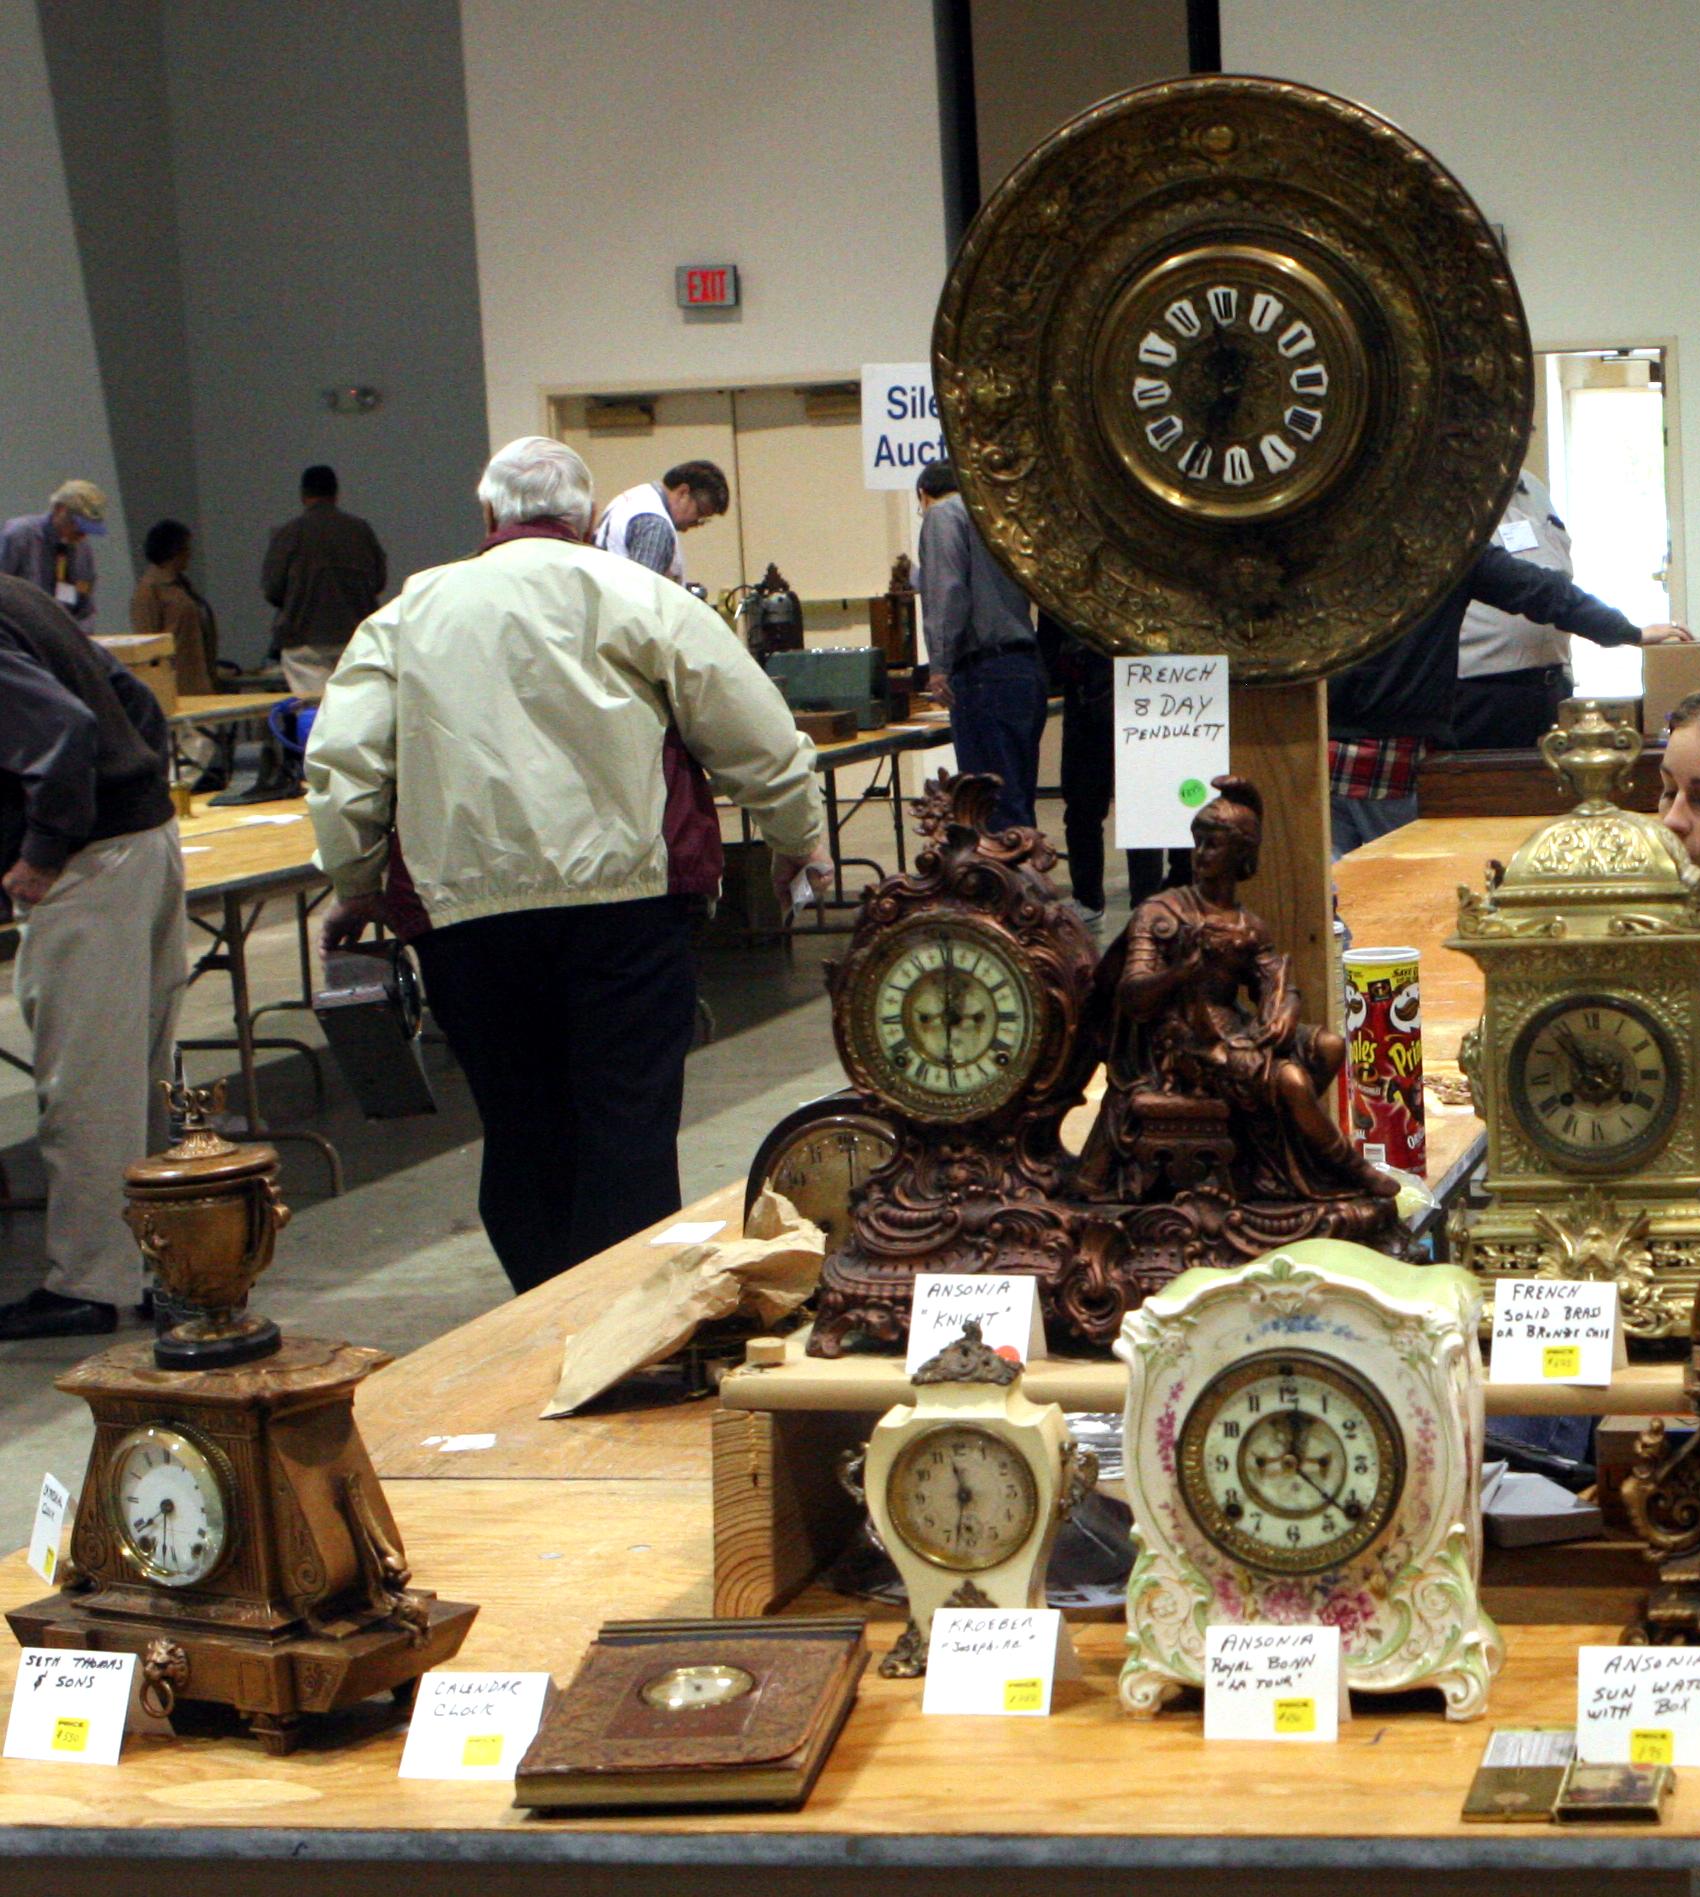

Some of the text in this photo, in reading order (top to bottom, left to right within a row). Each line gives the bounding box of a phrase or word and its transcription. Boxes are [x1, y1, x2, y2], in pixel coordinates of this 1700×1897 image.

[687, 270, 727, 303] EXIT
[887, 385, 939, 420] Sile
[874, 434, 945, 467] Auct
[1127, 663, 1217, 687] FRENCH
[1134, 694, 1213, 722] 8 DAY
[927, 1280, 1010, 1298] ANSONIA
[1512, 1283, 1582, 1301] FRENCH
[1504, 1307, 1551, 1322] SOLID
[1220, 1633, 1314, 1653] ANSONIA
[55, 1675, 95, 1689] SONS
[1592, 1684, 1636, 1702] SUN
[433, 1703, 495, 1717] CLOCK
[1586, 1702, 1633, 1720] WITH
